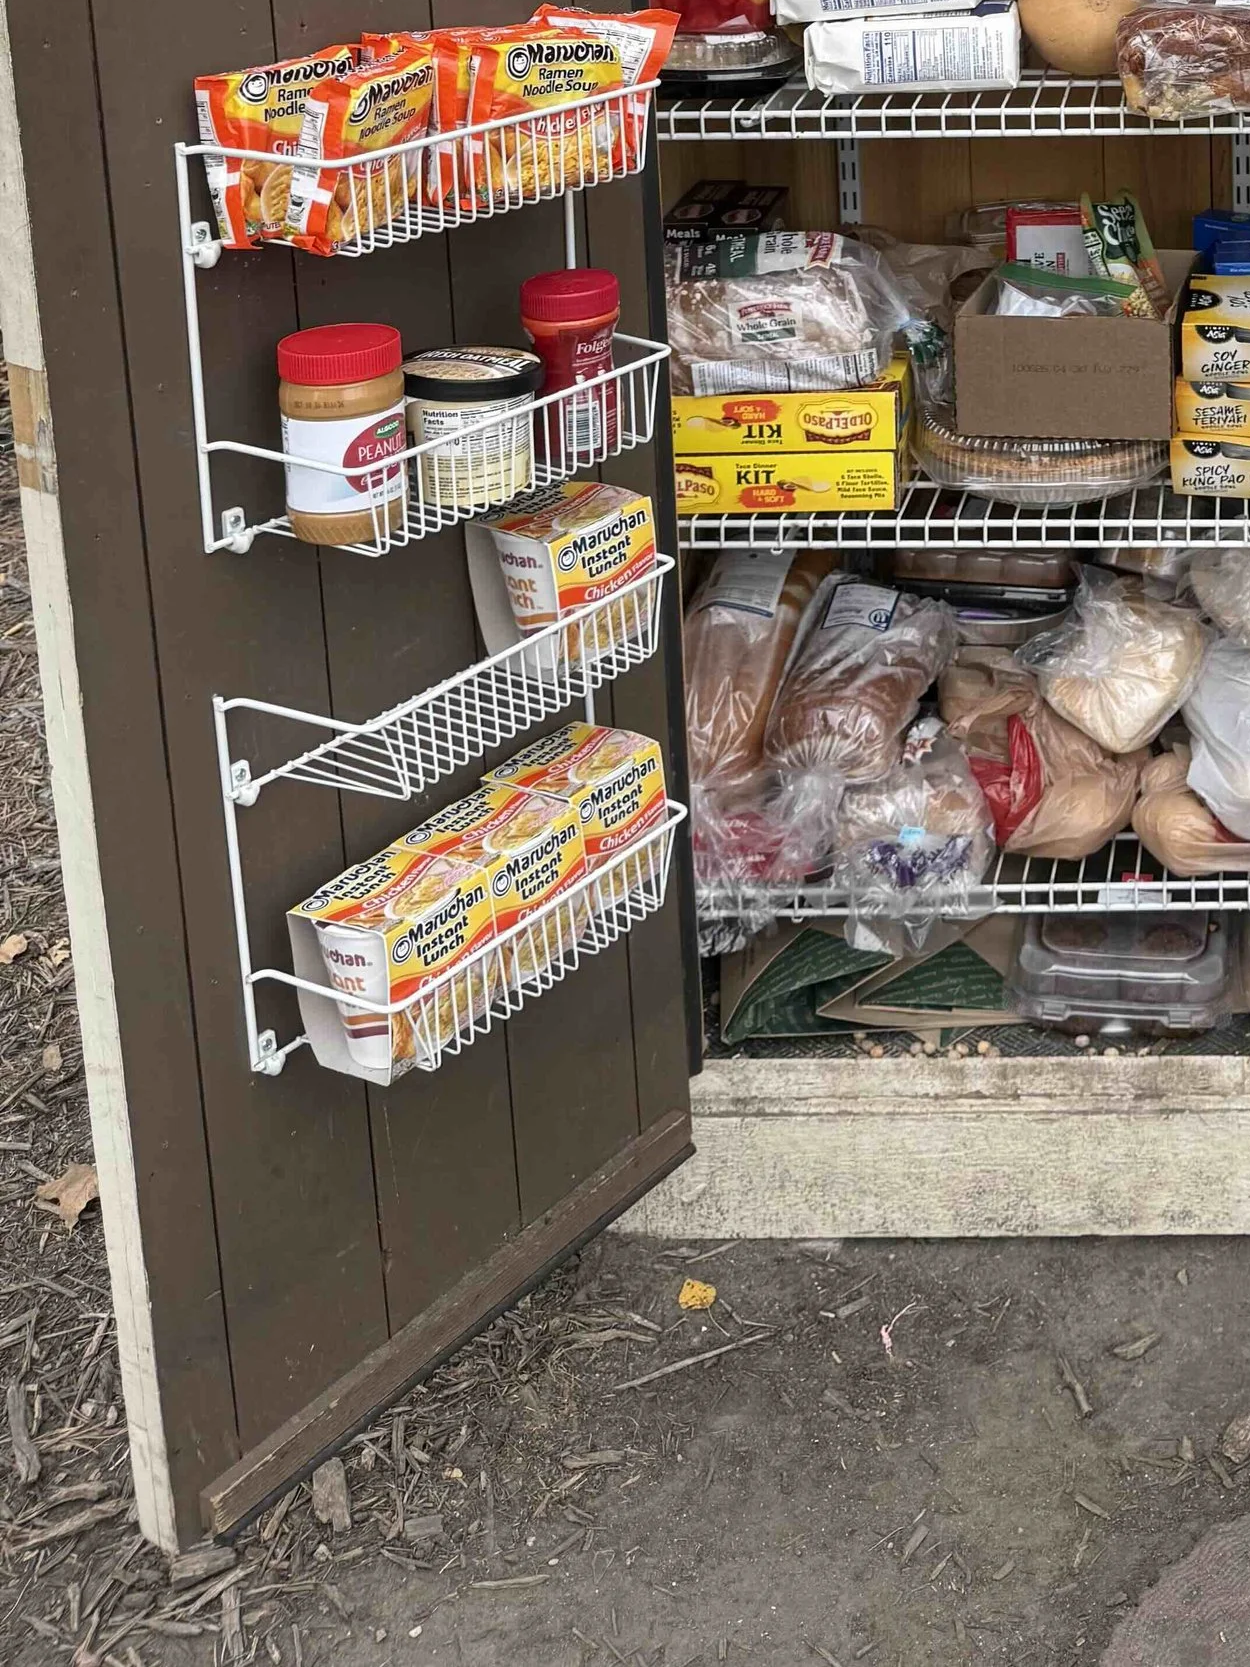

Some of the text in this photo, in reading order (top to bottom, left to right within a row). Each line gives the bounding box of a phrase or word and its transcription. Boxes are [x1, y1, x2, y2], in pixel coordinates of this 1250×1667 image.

[527, 42, 614, 64] Maruchan
[369, 65, 433, 107] Maruchan
[523, 80, 599, 97] Noodle Soup
[539, 68, 584, 80] Ramen
[265, 102, 306, 122] Noodle
[374, 99, 406, 120] Ramen
[360, 108, 416, 141] Noodle Soup
[666, 229, 700, 238] Meals
[1227, 295, 1248, 308] SOY
[737, 318, 796, 331] Whole Grain
[460, 354, 530, 370] OATMEAL
[1201, 359, 1250, 374] GINGER
[1213, 349, 1238, 363] SOY
[423, 410, 458, 418] Nutrition
[734, 405, 757, 414] SOFT
[850, 412, 872, 426] OLD
[1192, 415, 1247, 426] TERIYAKI
[1195, 405, 1243, 417] SESAME
[742, 424, 783, 438] KIT
[358, 432, 401, 462] PEANUT
[736, 470, 775, 485] KIT
[1182, 474, 1245, 488] KUNG PAO
[1195, 464, 1231, 476] SPICY
[764, 495, 785, 504] SOFT
[573, 509, 646, 556] Maruchan
[581, 534, 632, 569] Instant
[589, 553, 627, 579] Lunch
[583, 568, 633, 602] Chicken
[505, 725, 577, 770] Maruchan
[522, 737, 572, 767] Instant
[537, 742, 577, 766] Lunch
[548, 742, 593, 774] Chicken
[590, 757, 657, 806] Maruchan
[417, 787, 496, 833] Maruchan
[436, 799, 490, 833] Instant
[598, 783, 644, 820] Instant
[604, 800, 640, 829] Lunch
[451, 806, 496, 833] Lunch
[461, 809, 513, 841] Chicken
[600, 817, 645, 851] Chicken
[505, 824, 577, 878] Maruchan
[313, 850, 396, 901] Maruchan
[333, 865, 392, 901] Instant
[350, 871, 397, 901] Lunch
[514, 851, 563, 892] Instant
[521, 869, 559, 901] Lunch
[362, 871, 416, 909] Chicken
[408, 886, 485, 944] Maruchan
[416, 914, 469, 958] Instant
[423, 933, 465, 967] Lunch
